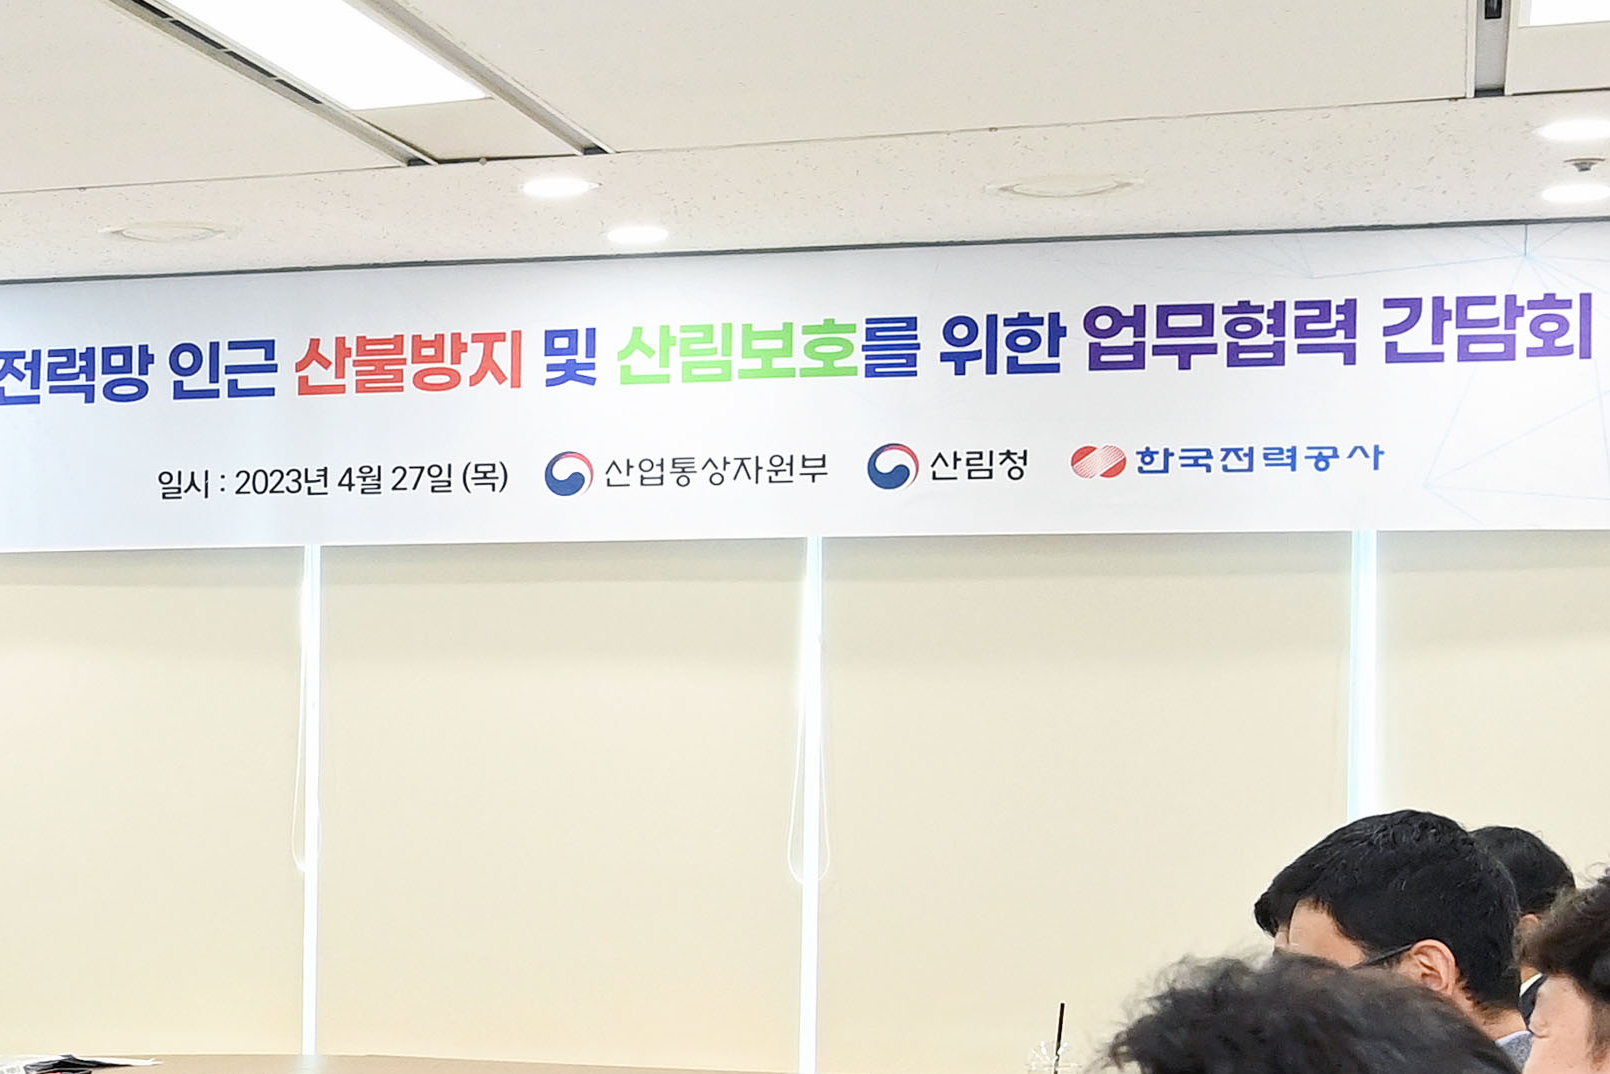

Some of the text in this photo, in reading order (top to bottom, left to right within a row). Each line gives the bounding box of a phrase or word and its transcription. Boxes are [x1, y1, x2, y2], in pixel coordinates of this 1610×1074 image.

[169, 339, 278, 400] 인근
[295, 330, 522, 396] 산불방지
[544, 327, 597, 387] 및
[618, 316, 921, 385] 산림보호를
[940, 312, 1067, 376] 위한
[1083, 298, 1357, 371] 업무협력
[1383, 293, 1592, 364] 간담회
[605, 454, 828, 487] 산업통상자원부
[931, 449, 1027, 480] 산림청
[1136, 444, 1385, 474] 한국전력공사
[158, 470, 208, 500] 일시
[235, 466, 328, 496] 2023년
[338, 465, 382, 495] 4월
[391, 463, 452, 493] 27일
[462, 461, 508, 493] (목)
